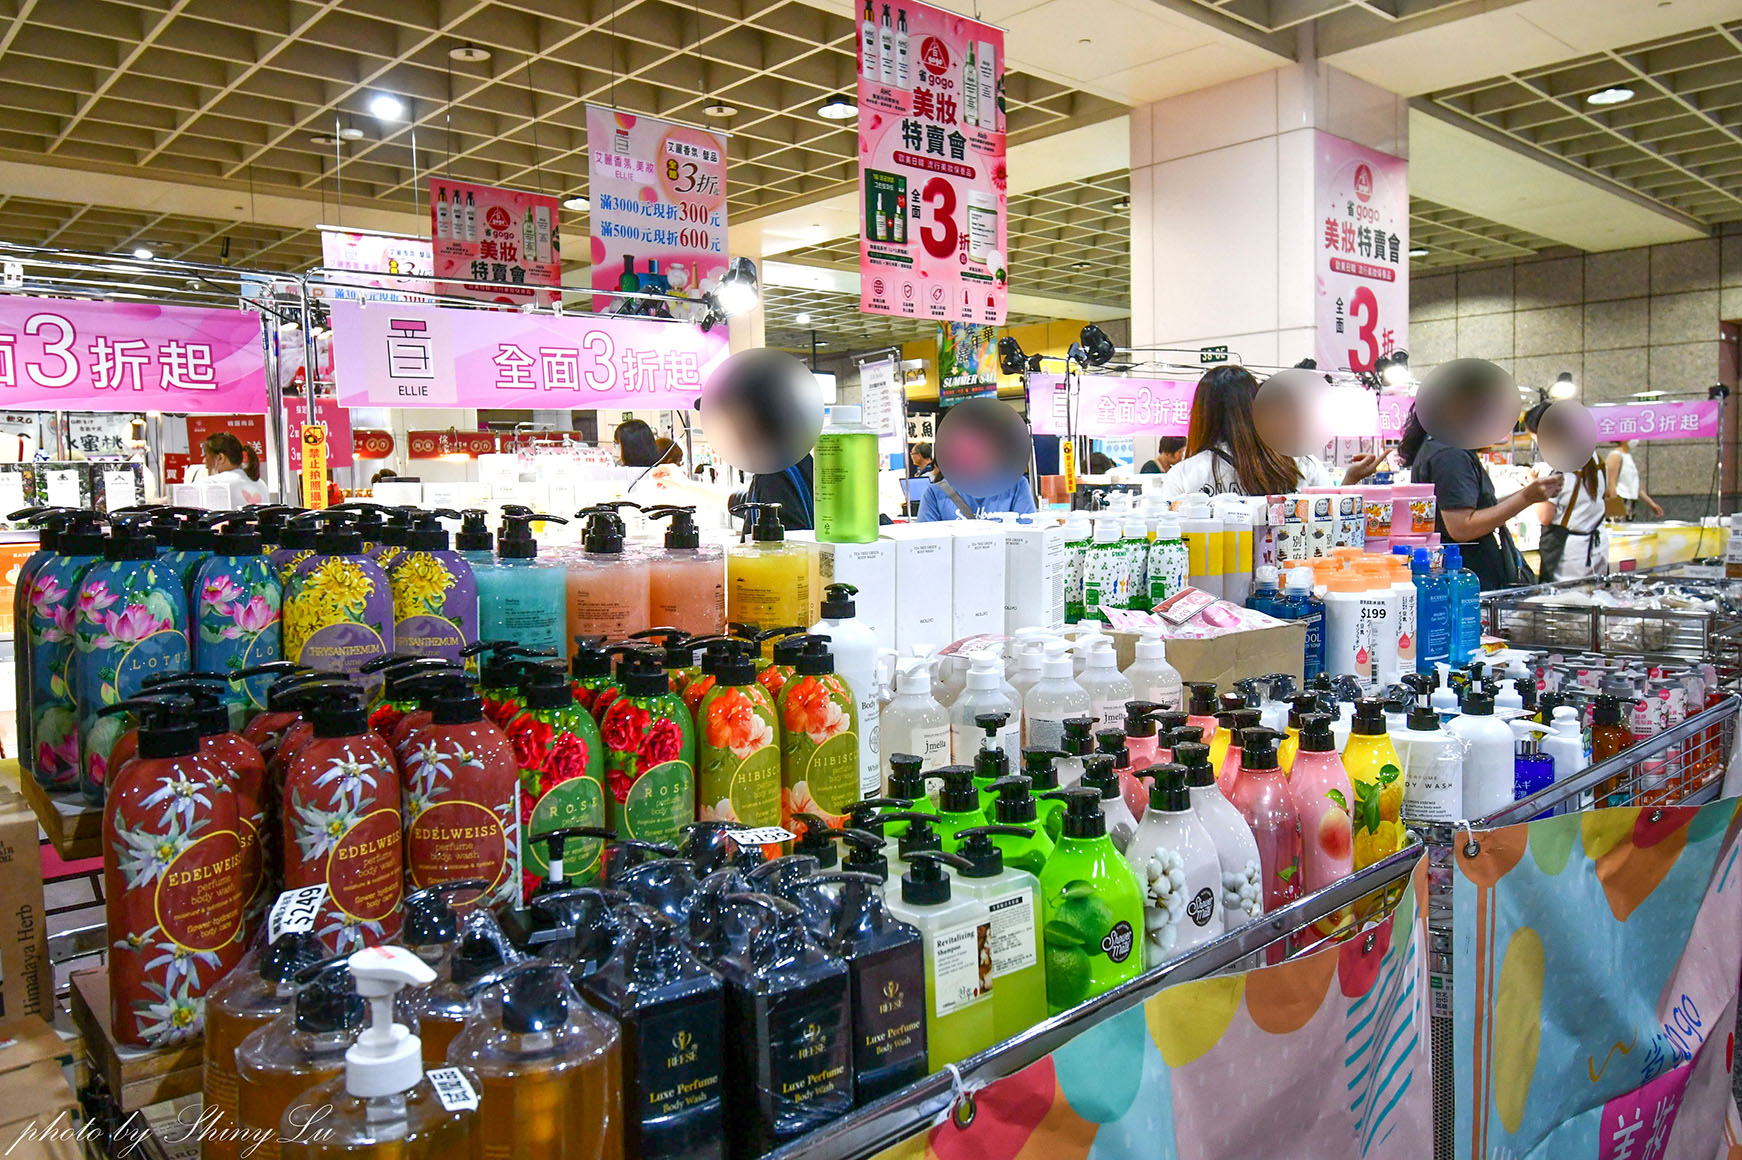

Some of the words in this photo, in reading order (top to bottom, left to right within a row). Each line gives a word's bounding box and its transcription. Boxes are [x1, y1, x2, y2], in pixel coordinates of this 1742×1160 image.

[913, 86, 957, 126] 美妝
[902, 118, 966, 161] 特賣會
[616, 170, 634, 182] ELLIE
[600, 194, 720, 227] 滿3000元現折300元
[911, 188, 920, 219] 全面
[920, 176, 958, 259] 3
[600, 220, 720, 252] 滿5000元現折600元
[1324, 217, 1400, 264] 美妝特賣會
[480, 240, 518, 264] 美妝
[471, 260, 526, 284] 特賣會
[1336, 297, 1344, 334] 全面
[1348, 286, 1379, 374] 3
[493, 330, 702, 393] 全面3折起
[398, 384, 428, 398] ELLIE
[942, 374, 978, 388] SUMMER
[1096, 386, 1190, 425] 全面3折起
[1600, 410, 1699, 434] 全面3折起
[1361, 608, 1386, 619] $199
[338, 829, 400, 861] EDELWEIS
[415, 824, 497, 841] EDELWEISS
[435, 842, 474, 851] perfume
[168, 852, 241, 887] EDELWEIS
[430, 850, 451, 862] body
[455, 850, 480, 860] wash
[286, 886, 322, 928] $249
[16, 904, 35, 942] Herb
[936, 930, 975, 948] Revitalizing
[1101, 930, 1132, 952] Shower
[20, 944, 41, 1018] Himalaya
[866, 1032, 887, 1047] Luxe
[888, 1020, 921, 1039] Perfume
[876, 1042, 893, 1056] Body
[894, 1036, 912, 1050] Wash
[650, 1088, 676, 1104] Luxe
[677, 1074, 719, 1096] Perfume
[782, 1079, 806, 1094] Luxe
[808, 1065, 845, 1086] Perfume
[794, 1090, 814, 1104] Body
[814, 1082, 835, 1096] Wash
[662, 1100, 684, 1114] Body
[686, 1092, 708, 1106] Wash
